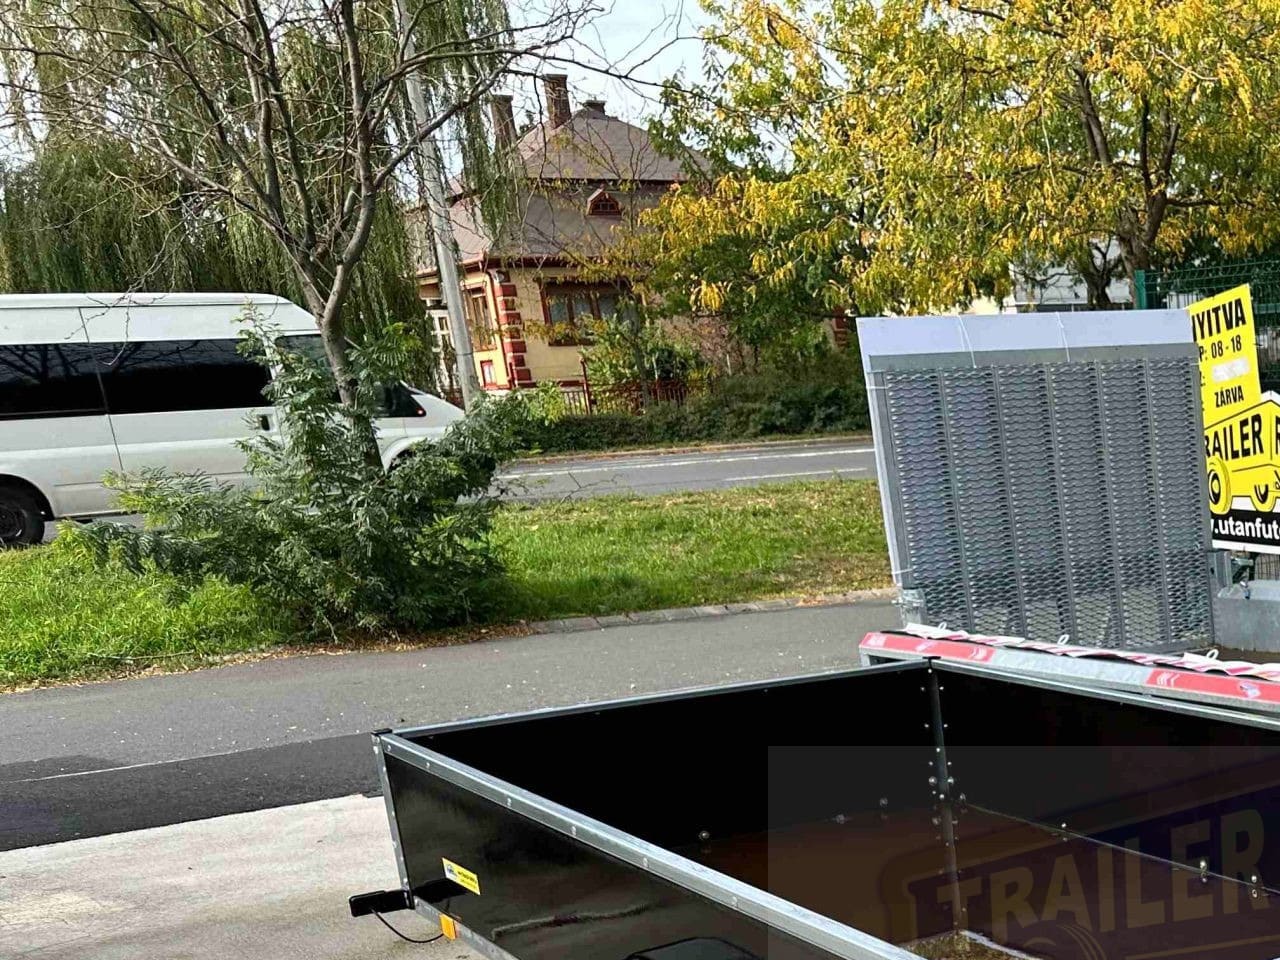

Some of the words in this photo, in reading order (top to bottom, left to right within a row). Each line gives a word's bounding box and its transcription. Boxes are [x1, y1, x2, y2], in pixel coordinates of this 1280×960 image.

[1211, 340, 1224, 359] 08
[1230, 334, 1242, 353] 18
[1214, 384, 1245, 408] ZÁRVA
